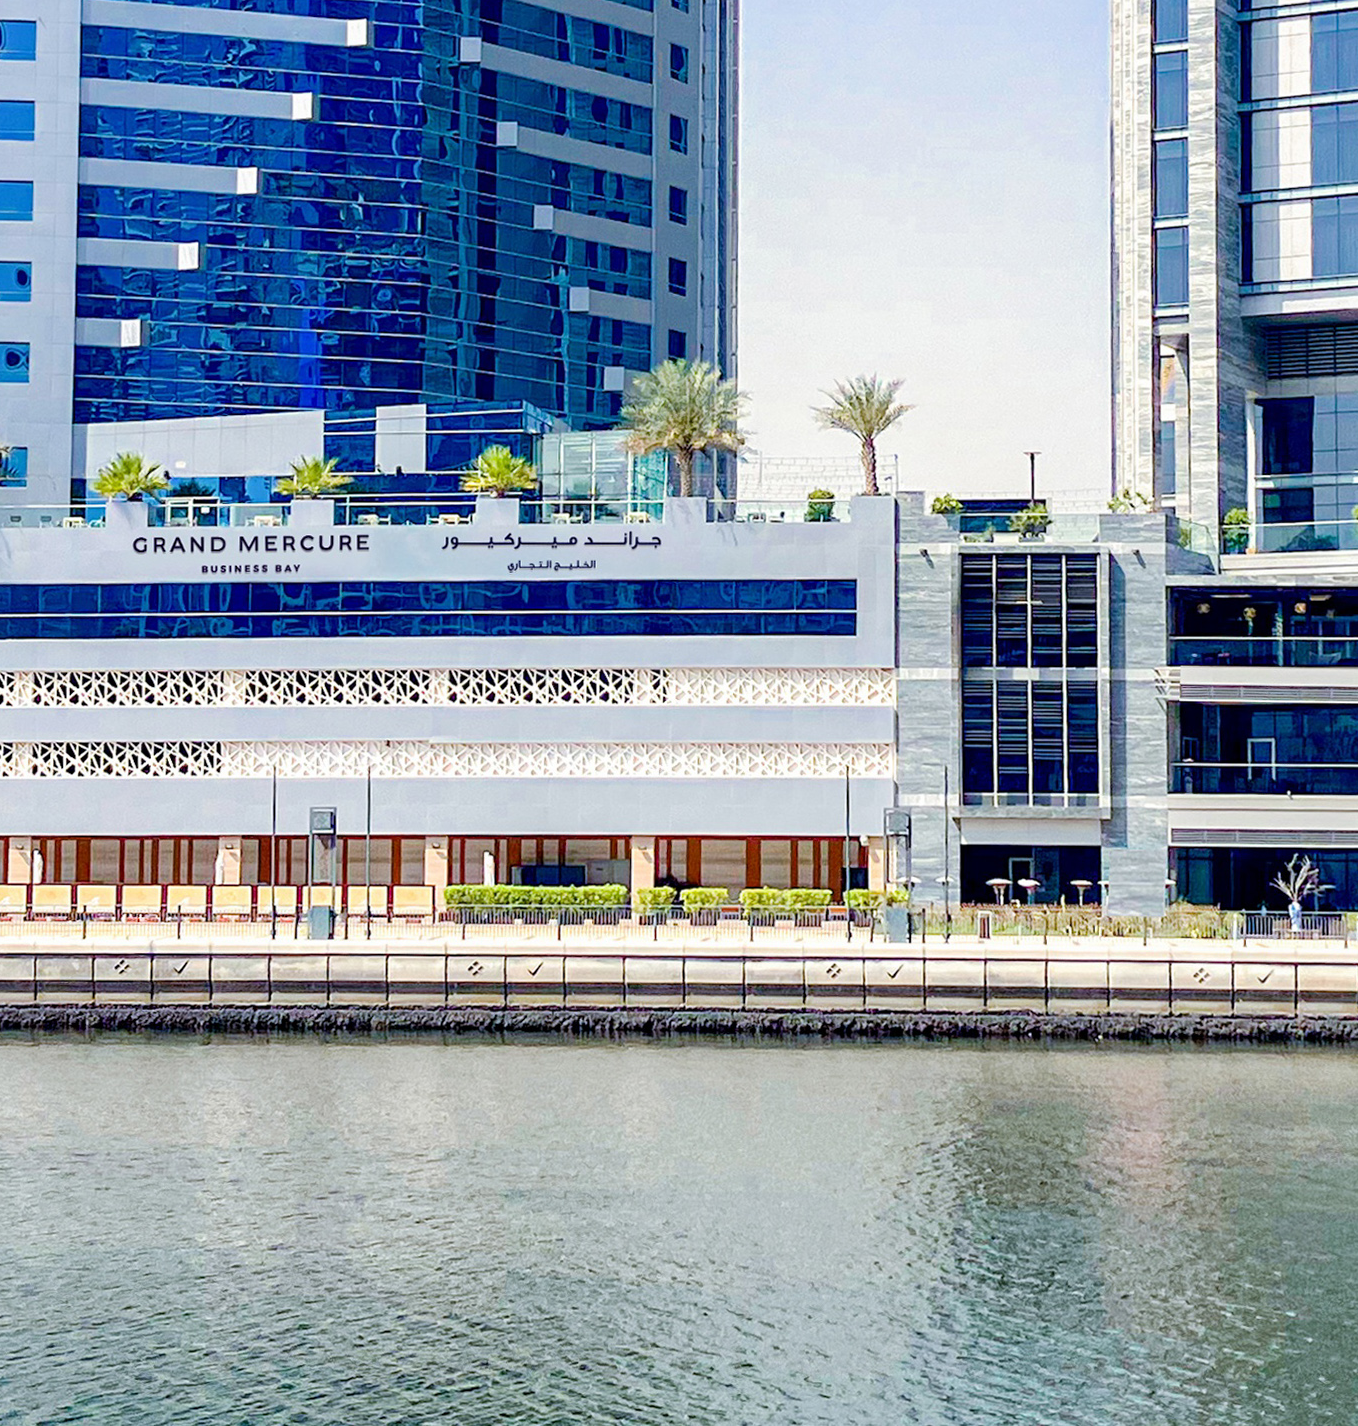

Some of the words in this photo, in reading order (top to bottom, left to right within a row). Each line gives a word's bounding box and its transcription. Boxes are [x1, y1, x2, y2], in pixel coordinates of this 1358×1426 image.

[132, 536, 227, 554] GRAND
[238, 534, 370, 553] MERCURE
[441, 532, 578, 550] ميركيور
[583, 530, 662, 550] جراند
[201, 564, 269, 574] BUSINESS
[274, 564, 301, 573] BAY
[507, 559, 553, 573] التجاري
[553, 559, 597, 572] الخليج
